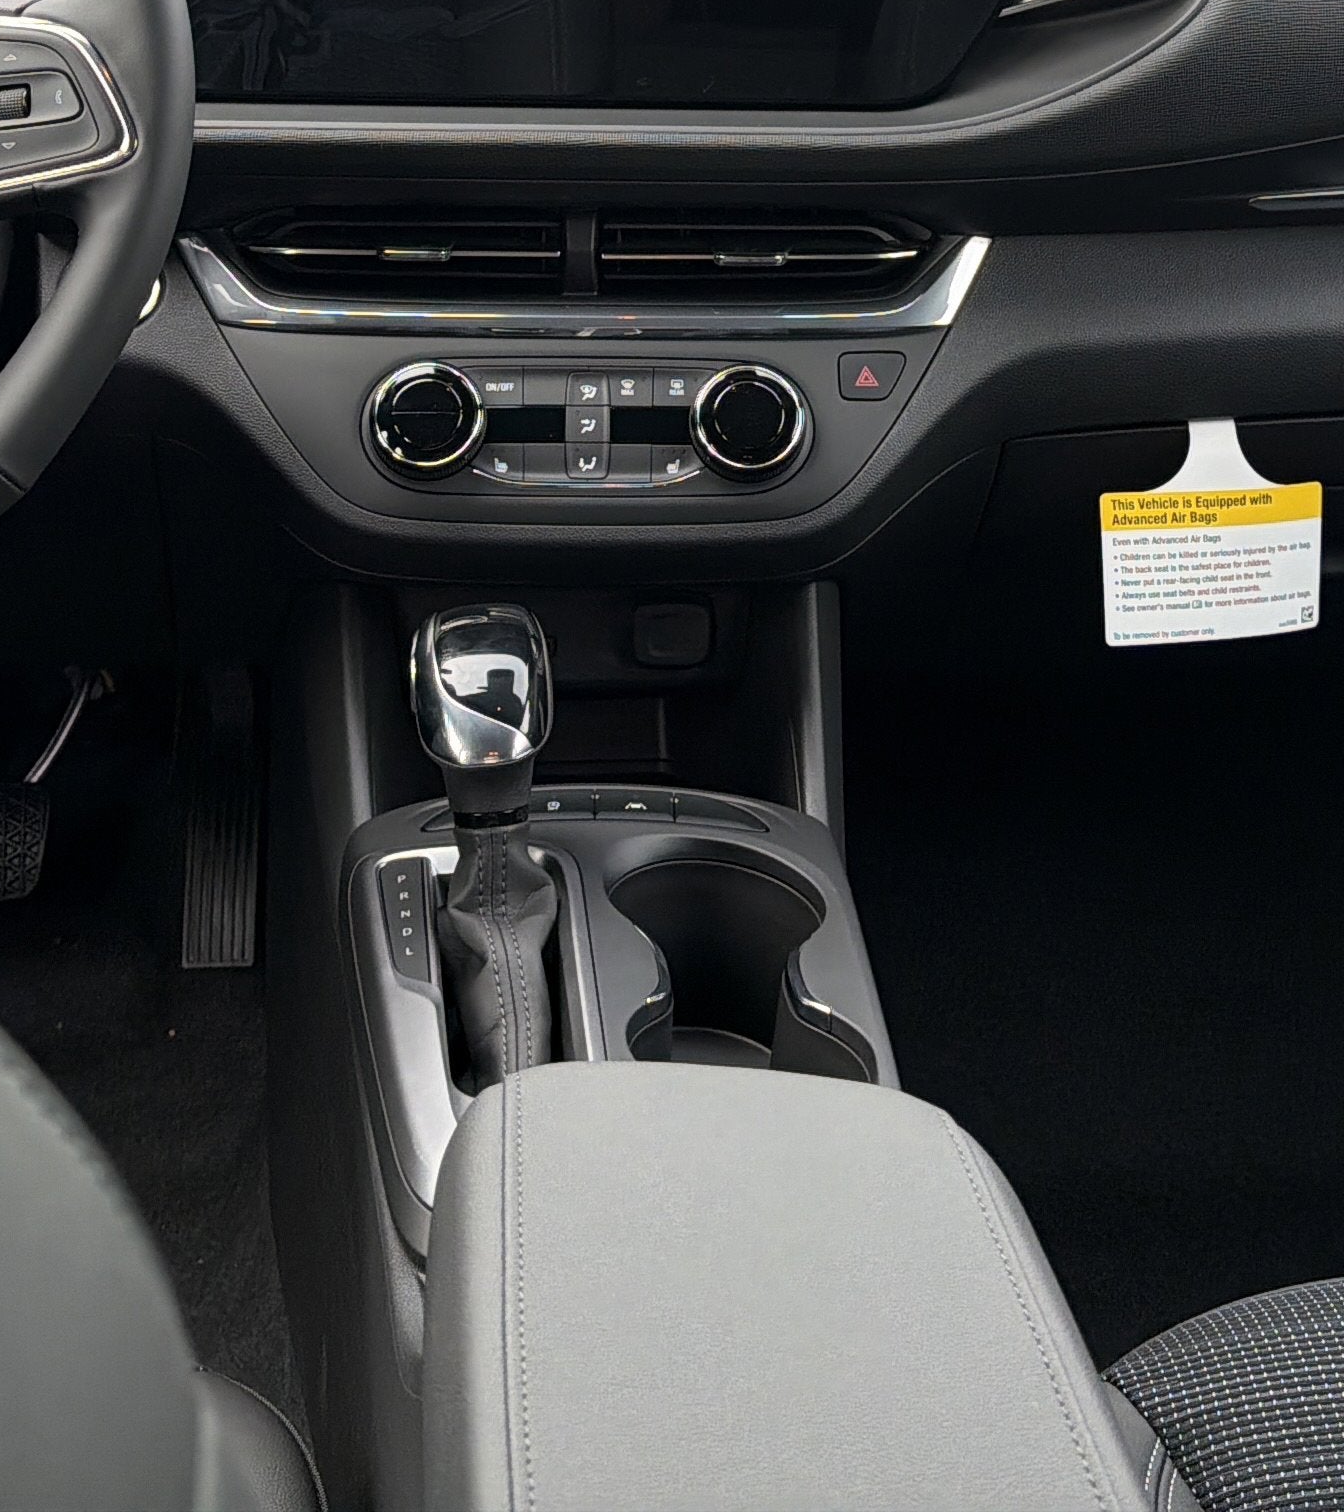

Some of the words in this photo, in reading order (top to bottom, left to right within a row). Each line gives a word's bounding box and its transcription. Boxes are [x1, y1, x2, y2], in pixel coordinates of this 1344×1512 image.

[485, 381, 515, 392] ON/OFF
[1111, 498, 1135, 511] This
[1137, 498, 1179, 510] Vehicle
[1182, 496, 1192, 509] is
[1195, 494, 1246, 510] Equipped
[1249, 493, 1273, 505] with
[1112, 512, 1167, 526] Advanced
[1170, 512, 1186, 524] Air
[1189, 511, 1217, 525] Bags
[1112, 537, 1131, 547] Even
[1133, 537, 1149, 545] with
[1152, 536, 1188, 545] Advanced
[1190, 534, 1201, 543] Air
[1202, 534, 1222, 544] Bags
[1119, 552, 1150, 561] Children
[396, 874, 407, 884] P
[399, 891, 409, 901] R
[400, 909, 411, 919] N
[402, 927, 413, 937] D
[405, 947, 414, 956] L
